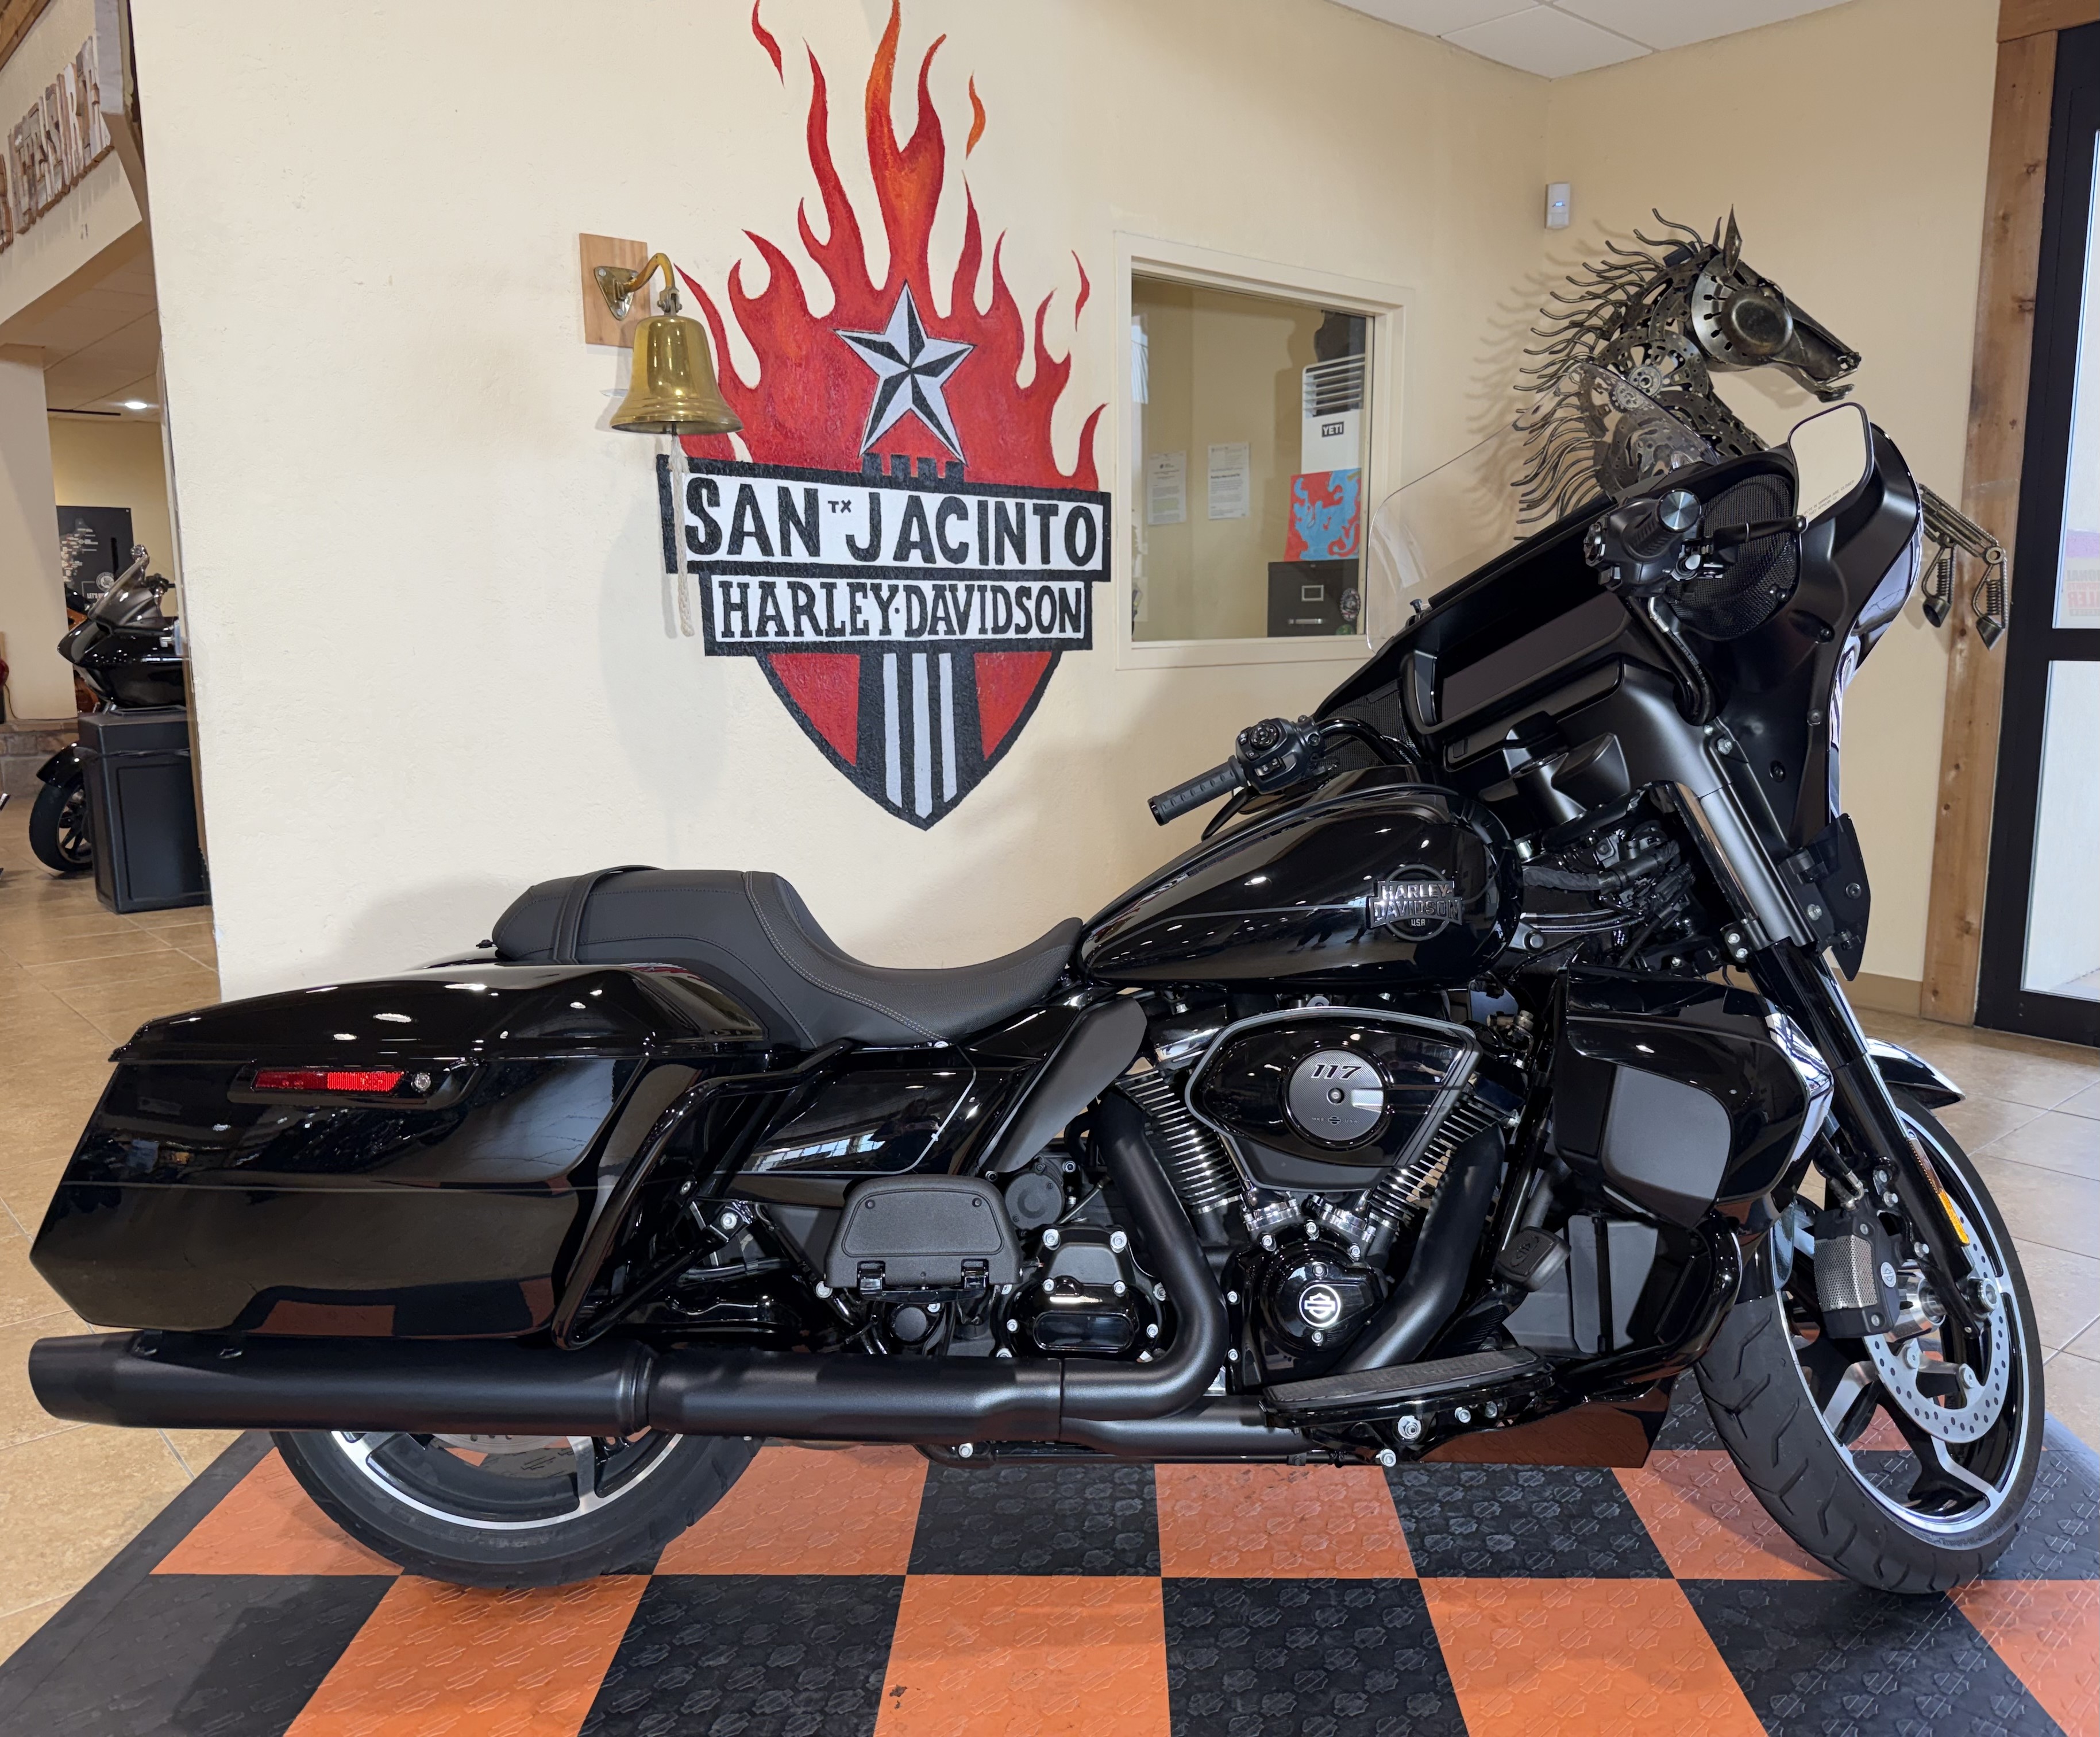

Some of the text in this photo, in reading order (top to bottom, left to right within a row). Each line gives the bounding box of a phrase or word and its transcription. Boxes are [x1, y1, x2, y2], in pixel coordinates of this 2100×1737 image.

[1323, 423, 1343, 435] YETI
[685, 477, 1096, 567] SAN TX JACINTO
[1374, 899, 1459, 921] DAVIDSON
[1411, 918, 1425, 927] USA
[1311, 1063, 1364, 1080] 117
